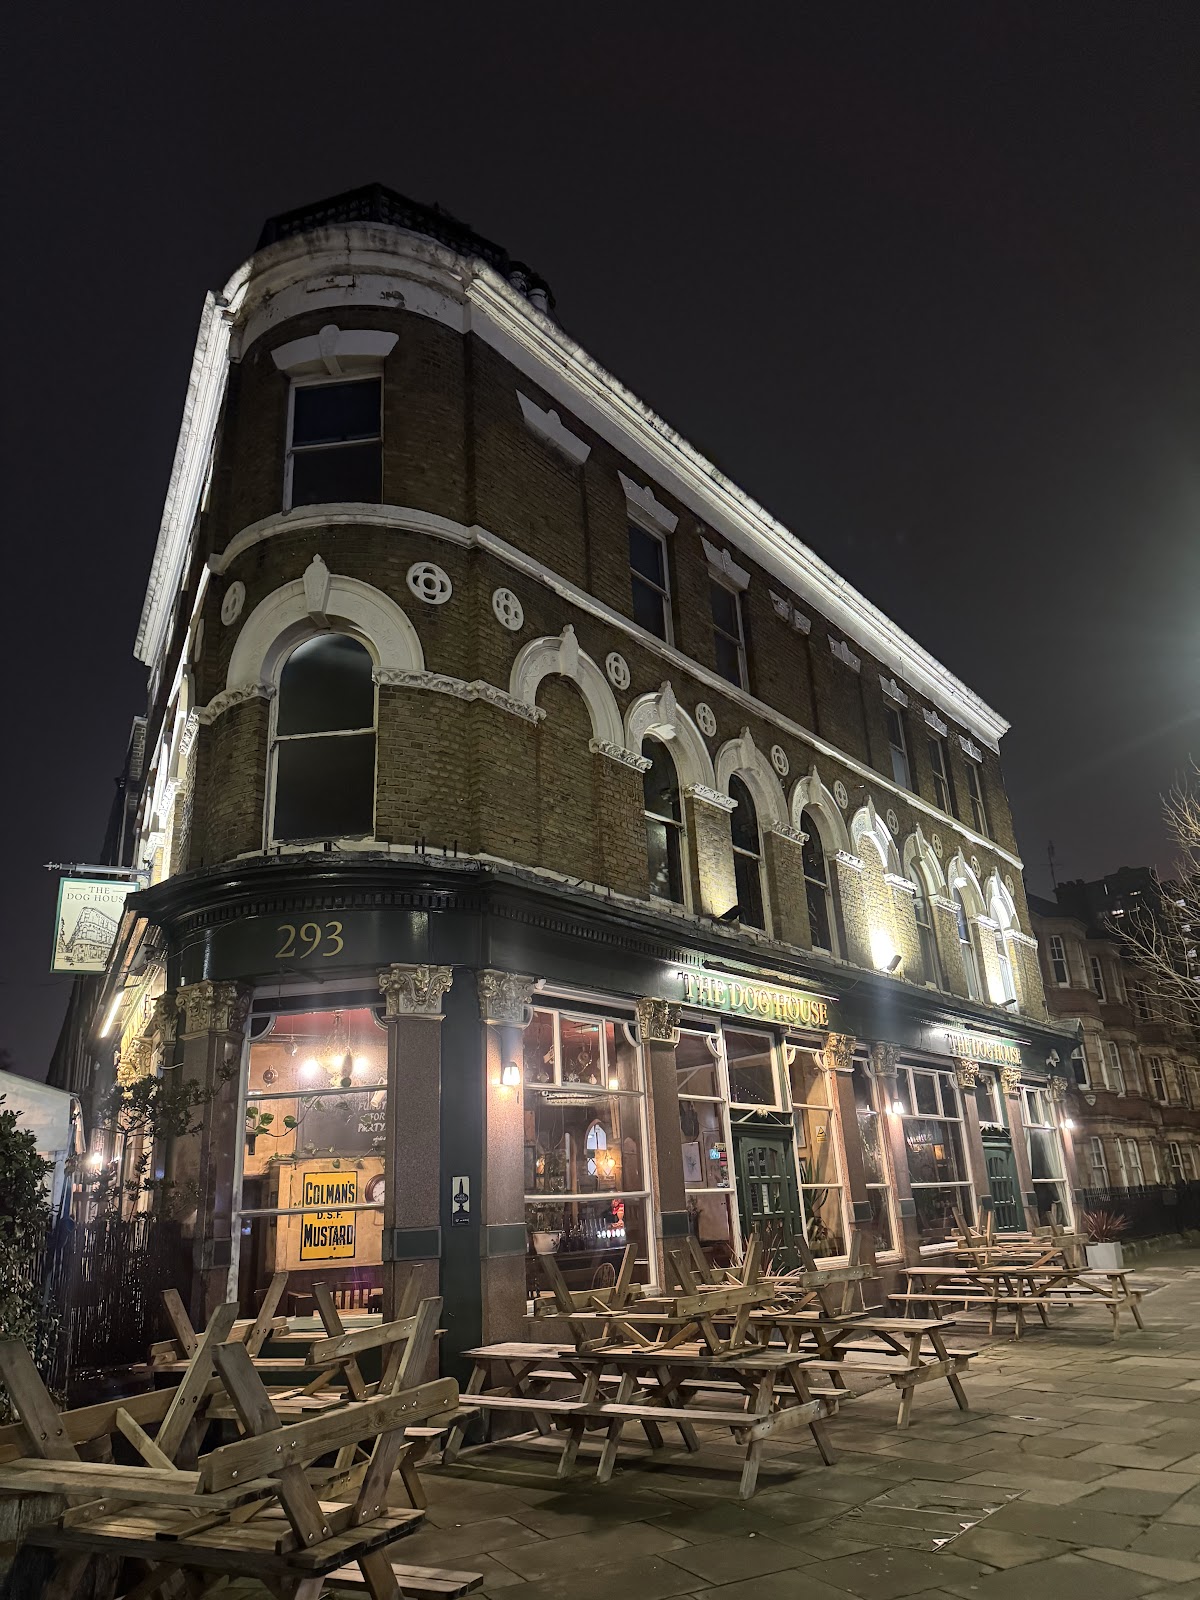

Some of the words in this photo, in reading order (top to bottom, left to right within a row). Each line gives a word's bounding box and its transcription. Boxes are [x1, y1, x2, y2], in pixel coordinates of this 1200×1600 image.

[66, 893, 90, 901] DOG
[94, 894, 124, 903] HOUS
[89, 886, 110, 894] THE
[274, 921, 344, 959] 293
[685, 974, 726, 1004] THE
[730, 982, 771, 1013] DOG
[774, 995, 829, 1026] HOUSE
[952, 1035, 972, 1054] THE
[972, 1039, 993, 1058] DOG
[993, 1045, 1022, 1064] HOUSE
[370, 1112, 386, 1121] FOR
[305, 1181, 355, 1206] COLMAN'S
[304, 1224, 353, 1247] MUSTARD
